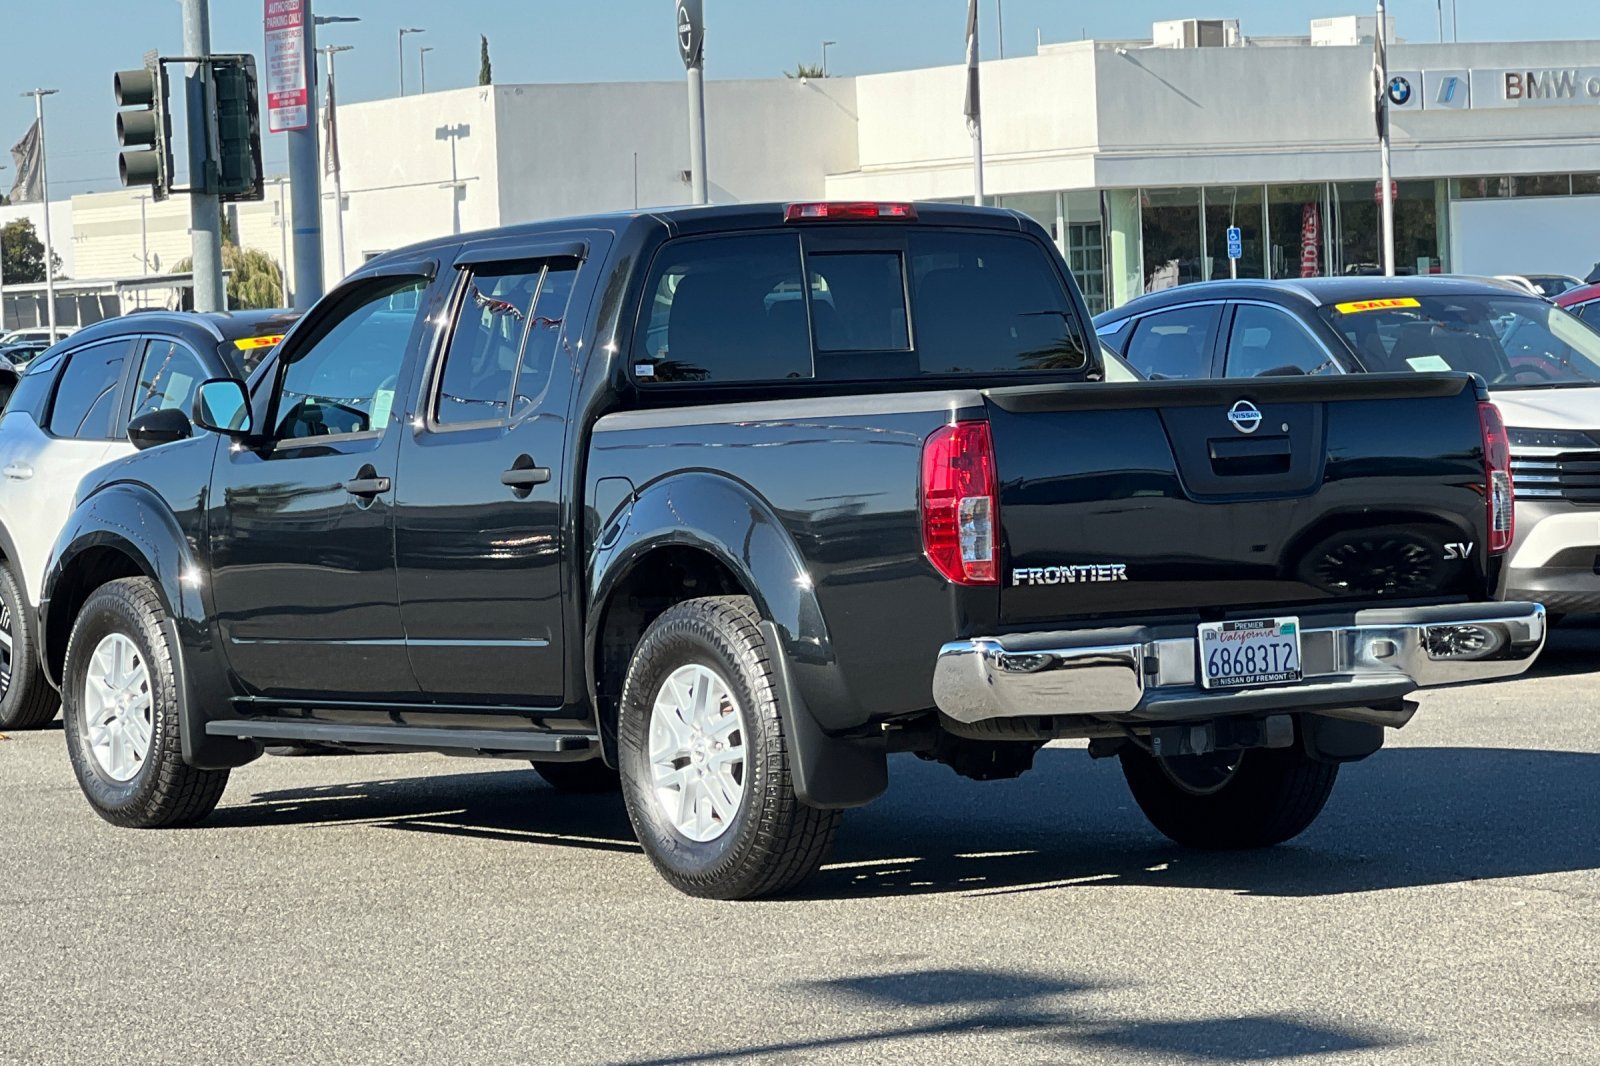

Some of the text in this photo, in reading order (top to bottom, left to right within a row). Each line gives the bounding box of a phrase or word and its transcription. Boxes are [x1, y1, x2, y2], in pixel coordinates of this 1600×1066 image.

[269, 0, 299, 13] AUTHORIZED
[266, 12, 302, 28] PARKING ONLY
[281, 28, 302, 40] ENFORCED
[1504, 70, 1579, 99] BMW
[1352, 299, 1404, 310] SALE
[1443, 541, 1474, 560] SV
[1012, 563, 1128, 586] FRONTIER
[1234, 621, 1264, 630] PREMIER
[1204, 629, 1280, 644] JUN California
[1208, 642, 1295, 677] 68683T2
[1220, 673, 1287, 685] NISSAN OF FREMONT
